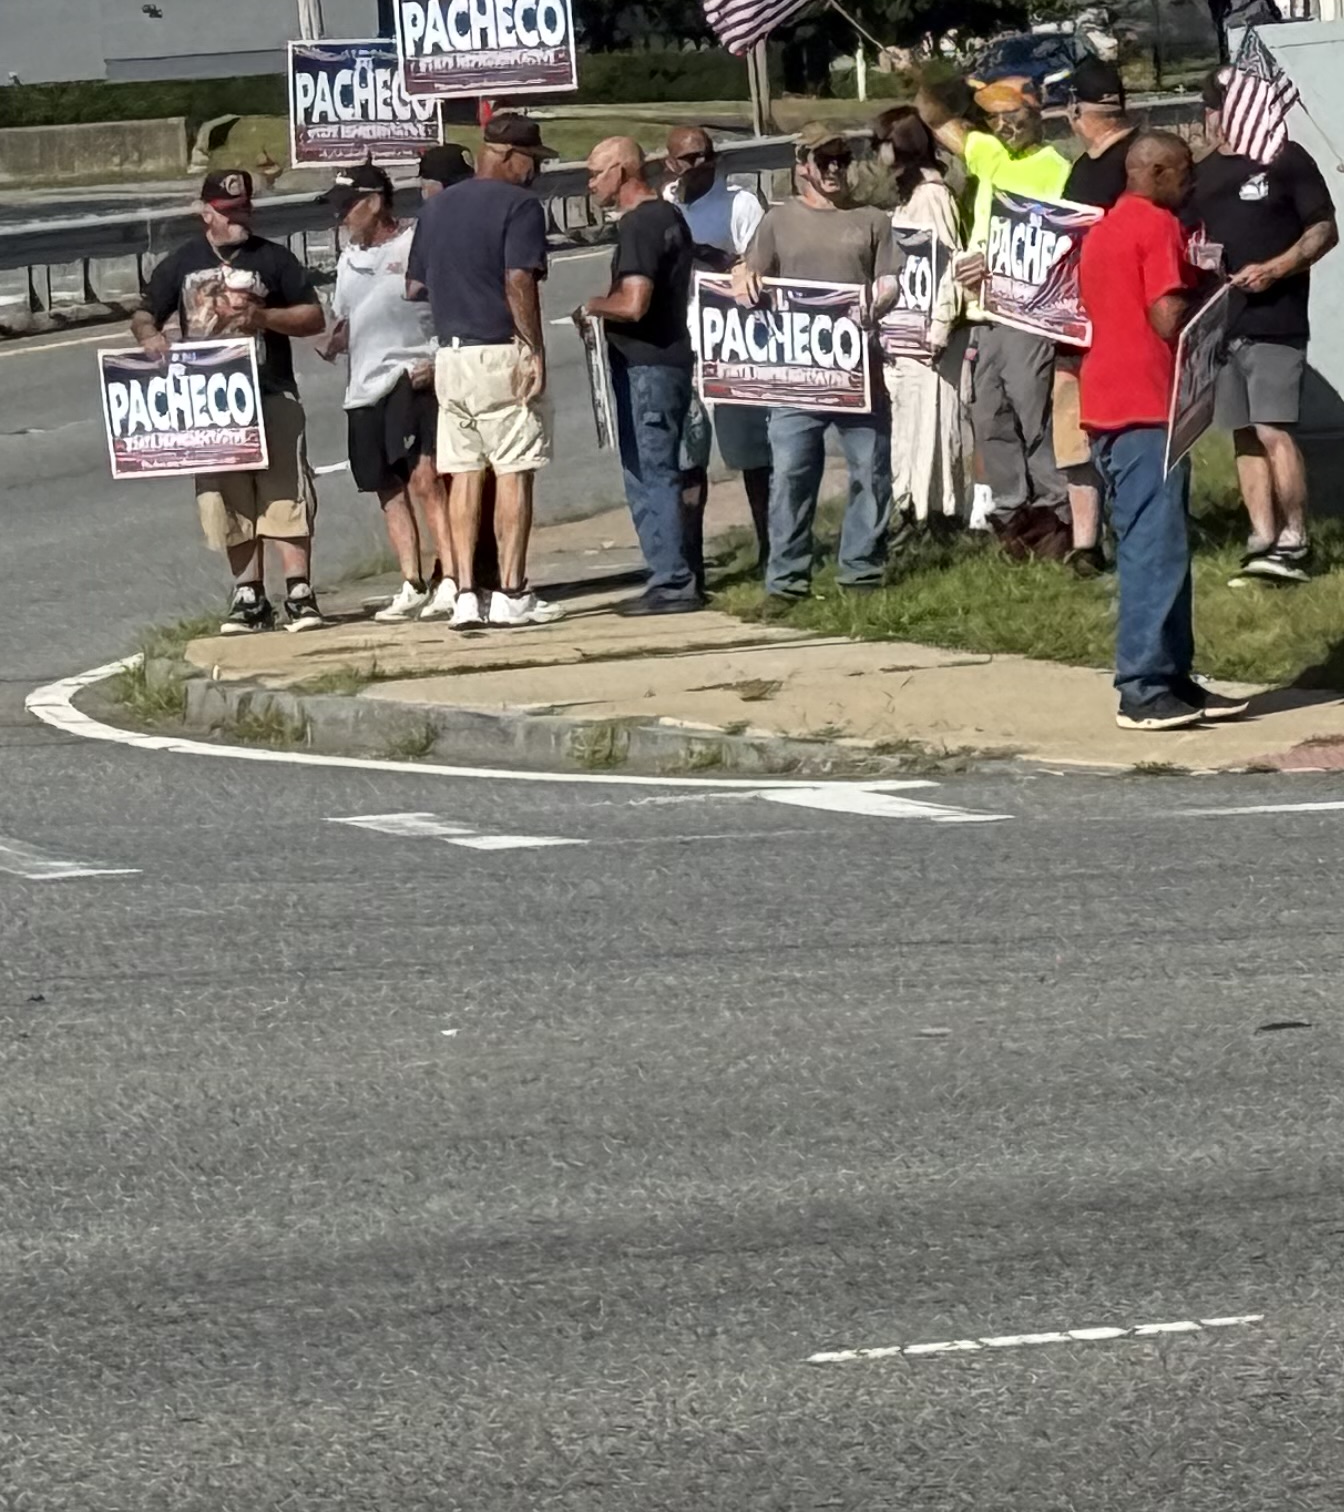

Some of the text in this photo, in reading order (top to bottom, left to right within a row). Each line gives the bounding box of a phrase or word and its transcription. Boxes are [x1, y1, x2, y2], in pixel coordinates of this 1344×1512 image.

[988, 215, 1073, 285] PACHE
[702, 307, 861, 371] PACHECO
[108, 372, 255, 437] PACHECO
